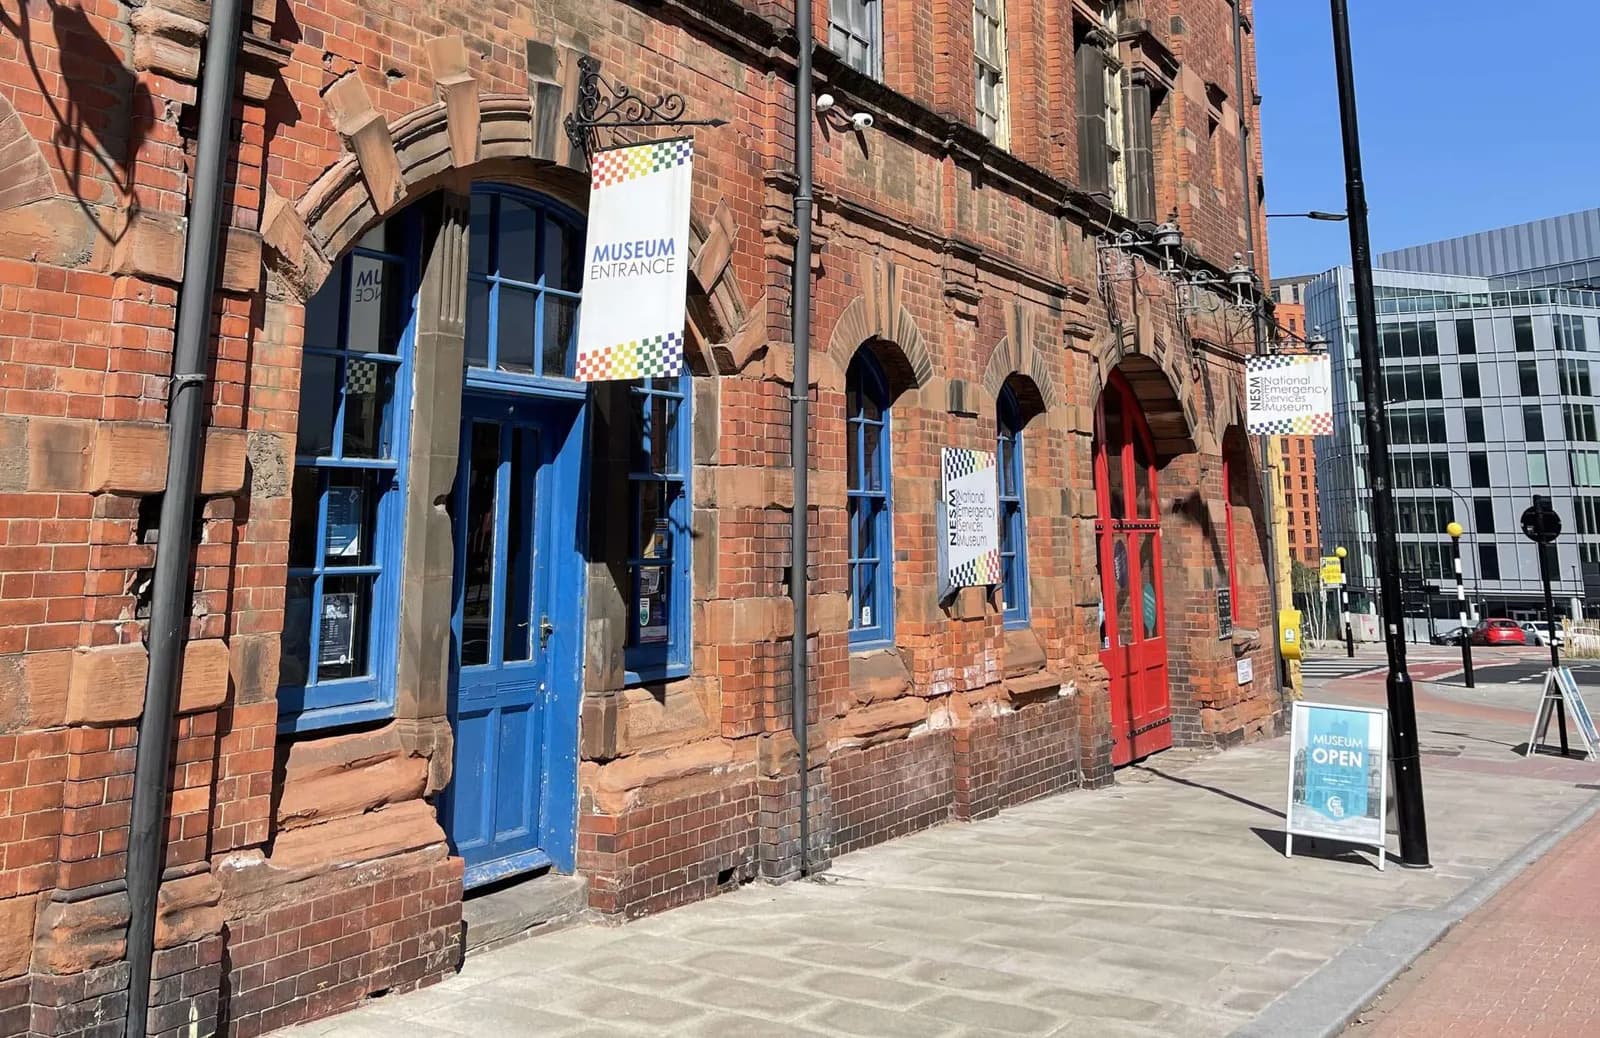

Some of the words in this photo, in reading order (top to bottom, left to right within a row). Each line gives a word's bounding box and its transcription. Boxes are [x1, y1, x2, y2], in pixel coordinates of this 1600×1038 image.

[592, 237, 675, 263] MUSEUM
[591, 257, 675, 280] ENTRANCE
[1264, 376, 1311, 386] National
[1249, 376, 1261, 411] NESM
[1264, 385, 1328, 396] Emergency
[1264, 394, 1307, 403] Services
[1264, 403, 1313, 412] Museum
[958, 490, 985, 504] National
[949, 489, 957, 546] NESM
[958, 506, 994, 522] Emergency
[958, 520, 984, 532] Services
[960, 534, 988, 547] Museum
[1313, 735, 1362, 748] MUSEUM
[1312, 748, 1362, 768] OPEN
